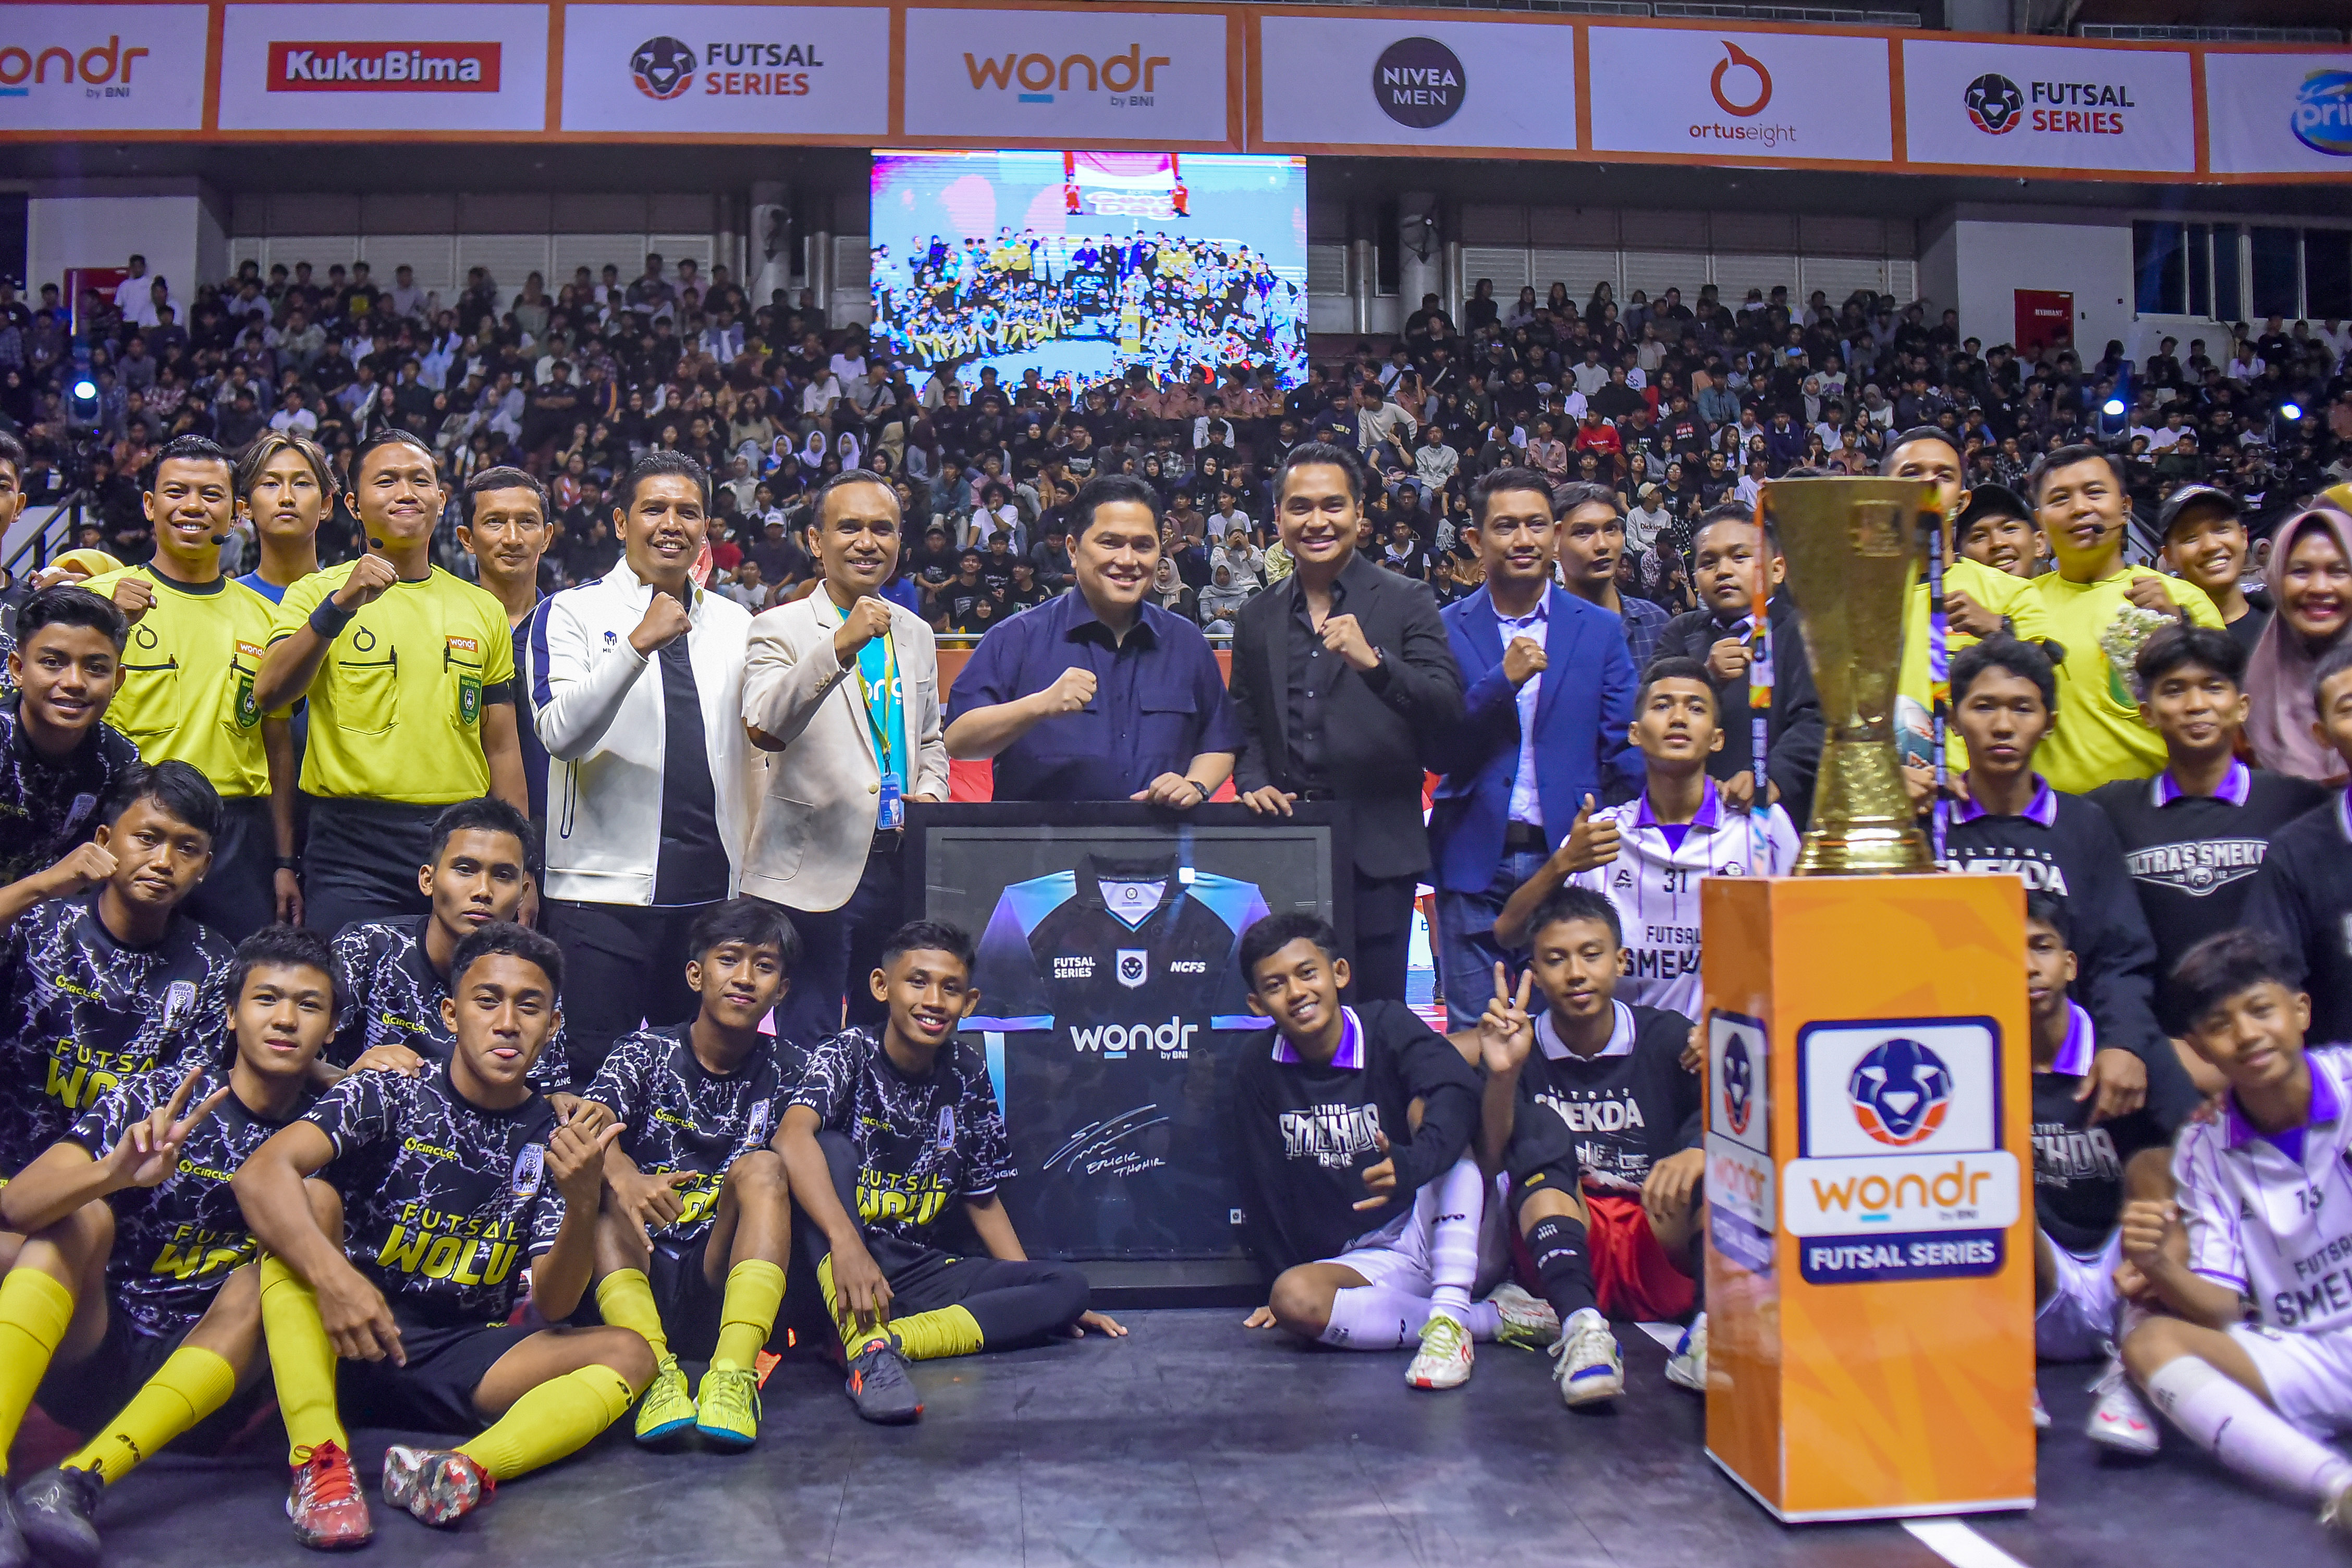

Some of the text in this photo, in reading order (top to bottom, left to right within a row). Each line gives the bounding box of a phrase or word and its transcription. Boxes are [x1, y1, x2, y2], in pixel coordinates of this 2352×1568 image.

[286, 50, 482, 82] KukuBima
[707, 44, 824, 67] FUTSAL
[963, 43, 1171, 92] wondr
[1383, 67, 1458, 87] NIVEA
[105, 88, 130, 97] BNI
[706, 72, 810, 96] SERIES
[2031, 81, 2135, 107] FUTSAL
[1110, 96, 1154, 107] by BNI
[1392, 90, 1447, 105] MEN
[2032, 110, 2124, 134] SERIES
[1689, 123, 1797, 147] ortuseight
[240, 643, 264, 656] wond
[450, 638, 475, 648] wondr
[1946, 847, 2052, 861] ULTRAS
[1663, 868, 1687, 893] 31
[1054, 957, 1206, 973] FUTSAL NCFS
[1054, 967, 1092, 978] SERIES
[174, 983, 193, 993] SMA
[175, 995, 188, 1006] 8
[1070, 1015, 1198, 1052] wondr
[55, 1038, 155, 1073] FUTSA
[1160, 1050, 1188, 1061] by BNI
[524, 1157, 537, 1169] 8
[1086, 1152, 1141, 1175] ERICK
[861, 1167, 944, 1192] FUTSAL
[1809, 1160, 1991, 1212] wondr
[2296, 1184, 2323, 1215] 13
[401, 1203, 519, 1241] FUTSAL
[376, 1223, 520, 1286] WOLU
[1808, 1241, 1996, 1271] FUTSAL SERIES
